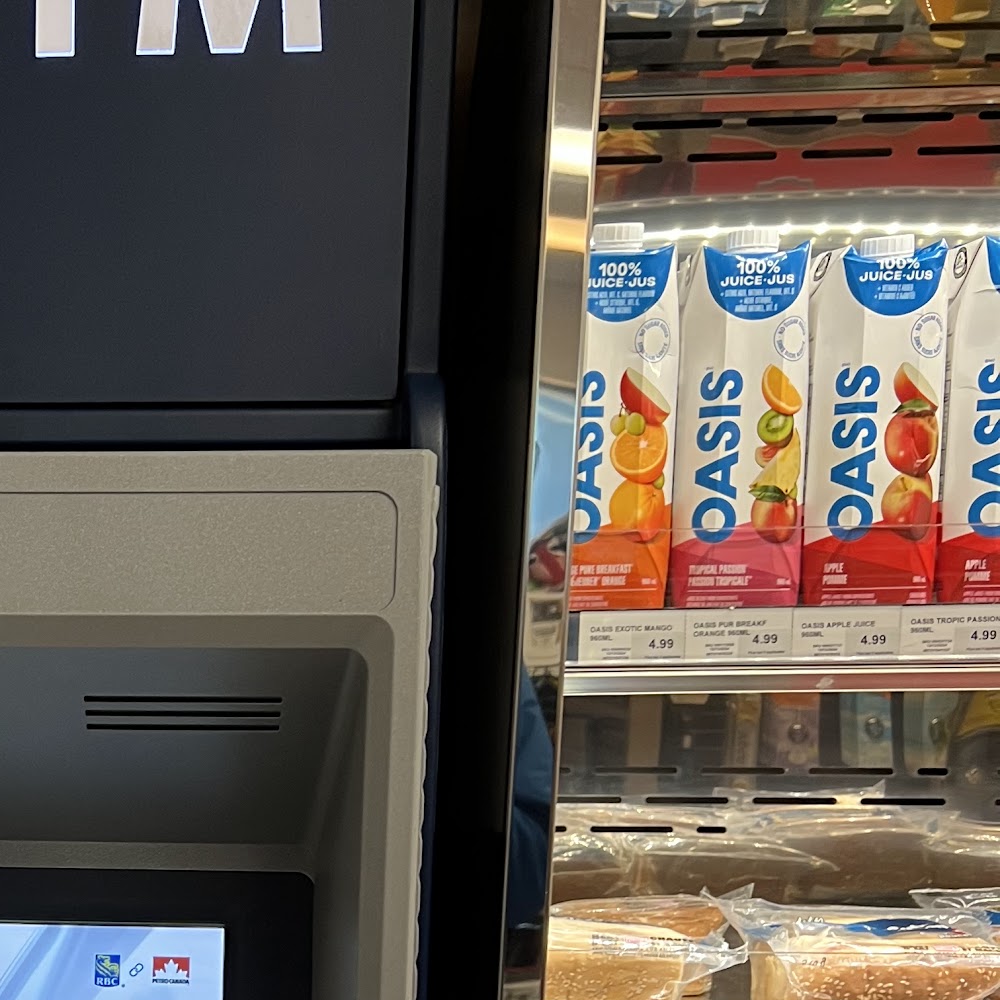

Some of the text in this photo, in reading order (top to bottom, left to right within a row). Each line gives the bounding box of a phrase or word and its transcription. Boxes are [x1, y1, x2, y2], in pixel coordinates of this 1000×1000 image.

[598, 261, 642, 277] 100%
[736, 258, 780, 275] 100%
[876, 257, 920, 270] 100%
[692, 369, 743, 544] OASIS
[827, 365, 881, 542] OASIS
[823, 562, 844, 573] APPLE
[964, 559, 987, 570] APPLE
[853, 620, 876, 628] JUICE
[937, 616, 965, 624] TROPIC
[693, 630, 726, 638] ORANGE
[752, 633, 778, 644] 4.99
[860, 634, 886, 645] 4.99
[971, 629, 997, 640] 4.99
[648, 638, 674, 649] 4.99
[96, 977, 119, 986] RBC
